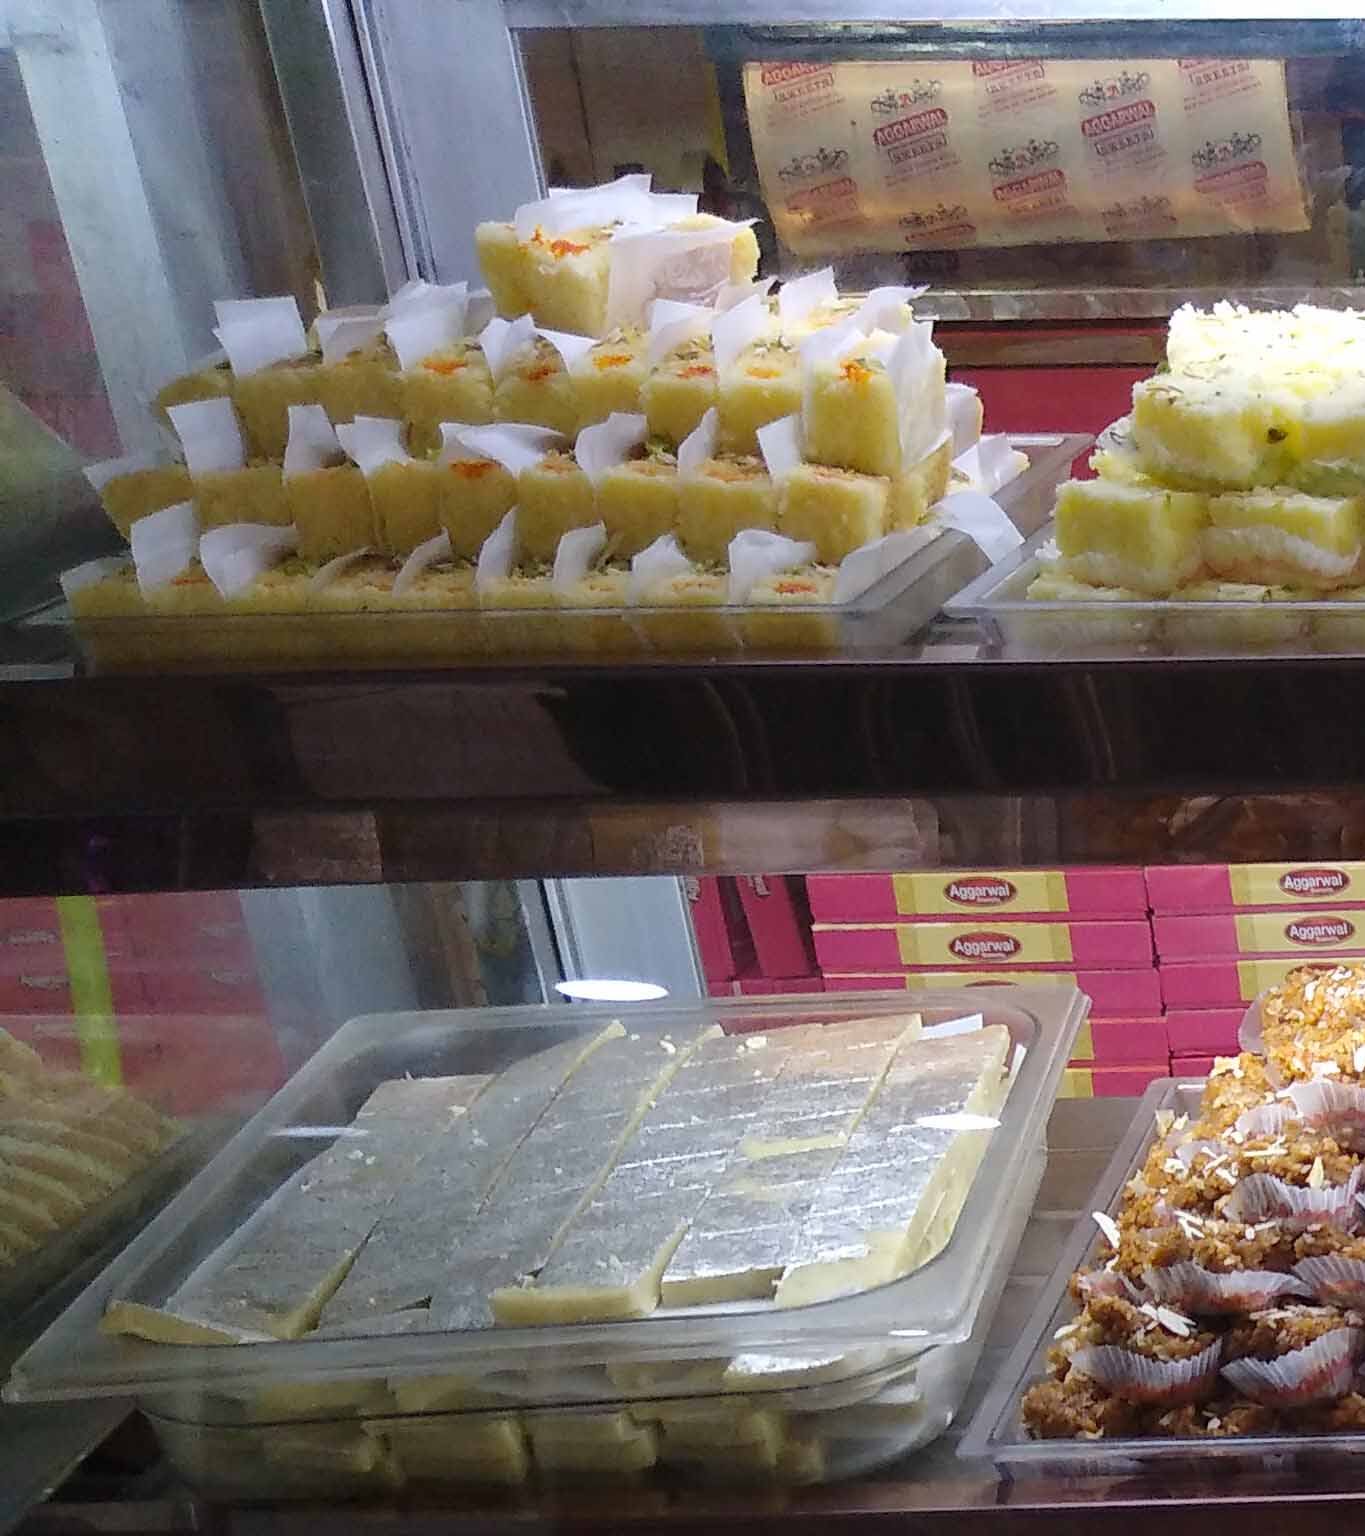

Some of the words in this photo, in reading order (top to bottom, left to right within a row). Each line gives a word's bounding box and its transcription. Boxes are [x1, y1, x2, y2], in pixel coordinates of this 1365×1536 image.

[1284, 873, 1343, 892] Aggarwal
[950, 884, 1010, 901] Aggarwal
[1289, 923, 1348, 941] Aggarwal
[955, 938, 1015, 957] Aggarwal
